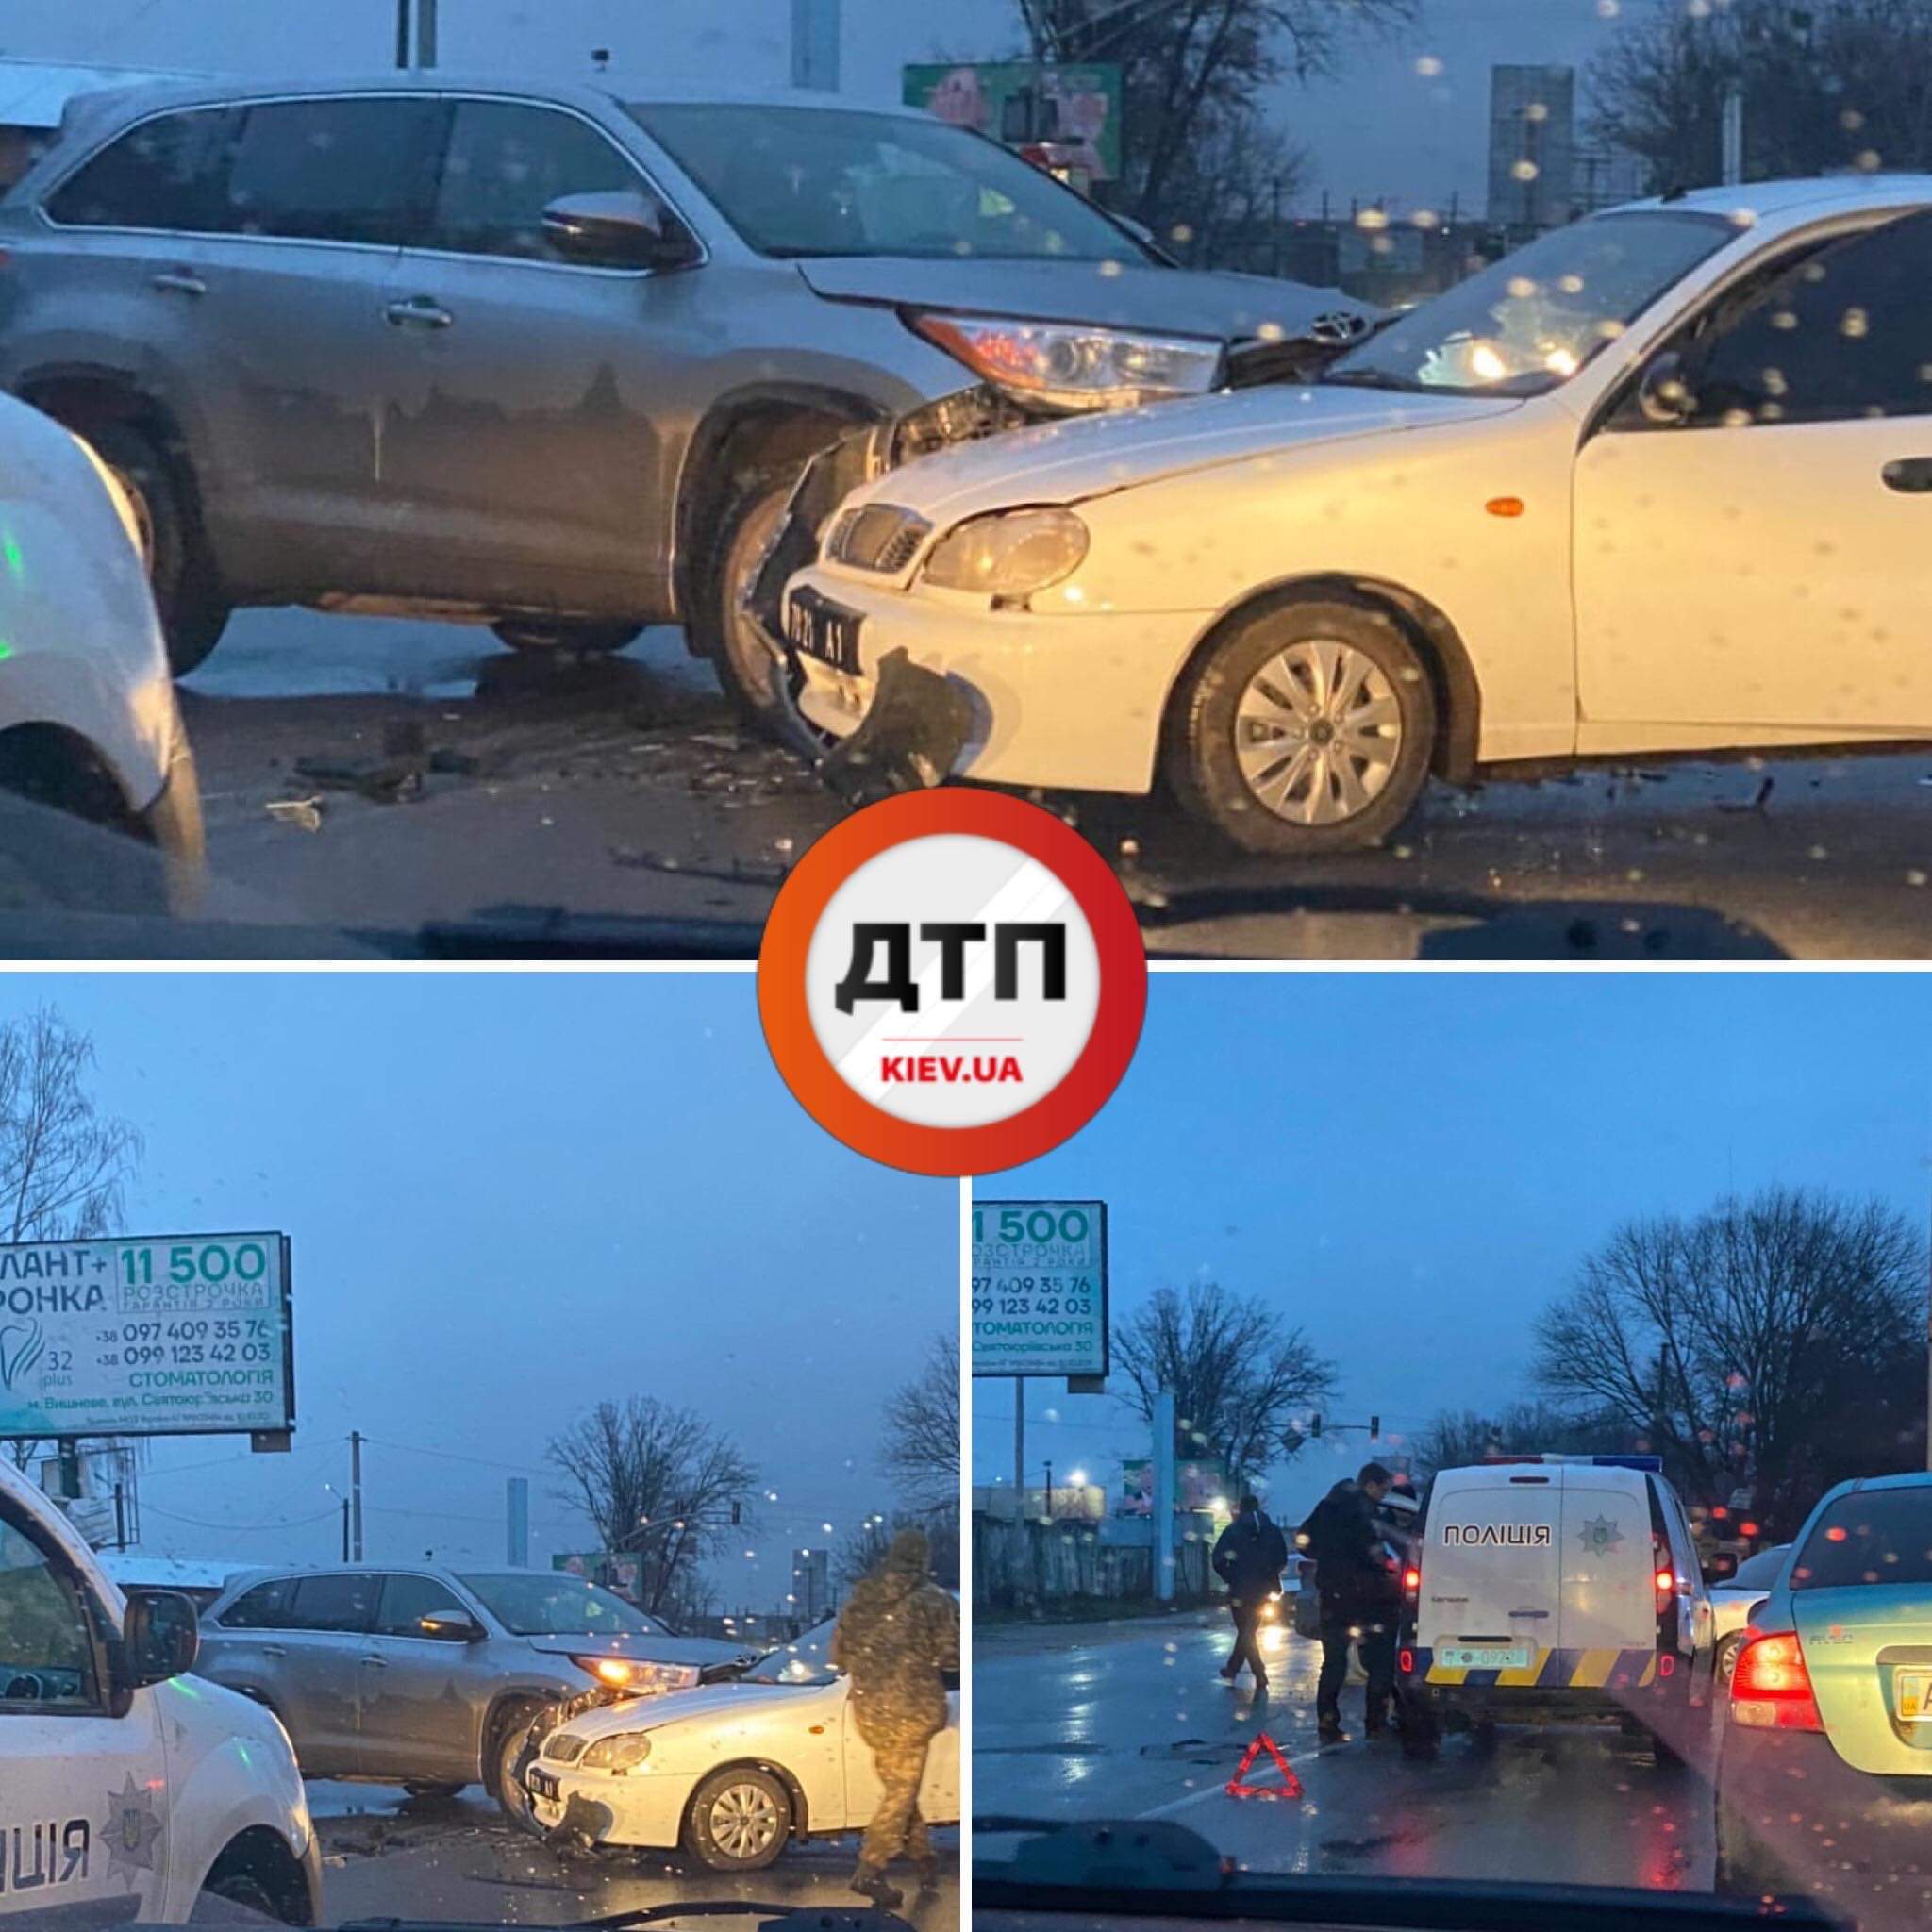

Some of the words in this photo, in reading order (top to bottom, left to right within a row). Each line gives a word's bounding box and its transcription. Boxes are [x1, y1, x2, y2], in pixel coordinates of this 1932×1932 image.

[998, 1209, 1089, 1243] 500
[121, 1247, 153, 1284] 11
[169, 1243, 266, 1284] 500
[123, 1282, 263, 1302] РОЗСТРОЧКА
[997, 1277, 1035, 1293] 409
[1041, 1278, 1063, 1293] 35
[1070, 1277, 1091, 1293] 76
[1000, 1298, 1030, 1314] 123
[1037, 1298, 1059, 1314] 42
[1065, 1298, 1091, 1314] 03
[123, 1323, 161, 1341] 097
[167, 1321, 208, 1341] 409
[214, 1321, 241, 1338] 35
[48, 1351, 73, 1371] 32
[124, 1346, 164, 1365] 099
[171, 1344, 204, 1363] 123
[210, 1344, 236, 1362] 42
[242, 1343, 271, 1362] 03
[43, 1373, 73, 1391] plus
[129, 1369, 274, 1389] СТОМАТОЛОГІЯ
[1444, 1524, 1551, 1546] ПОЛІЦІЯ
